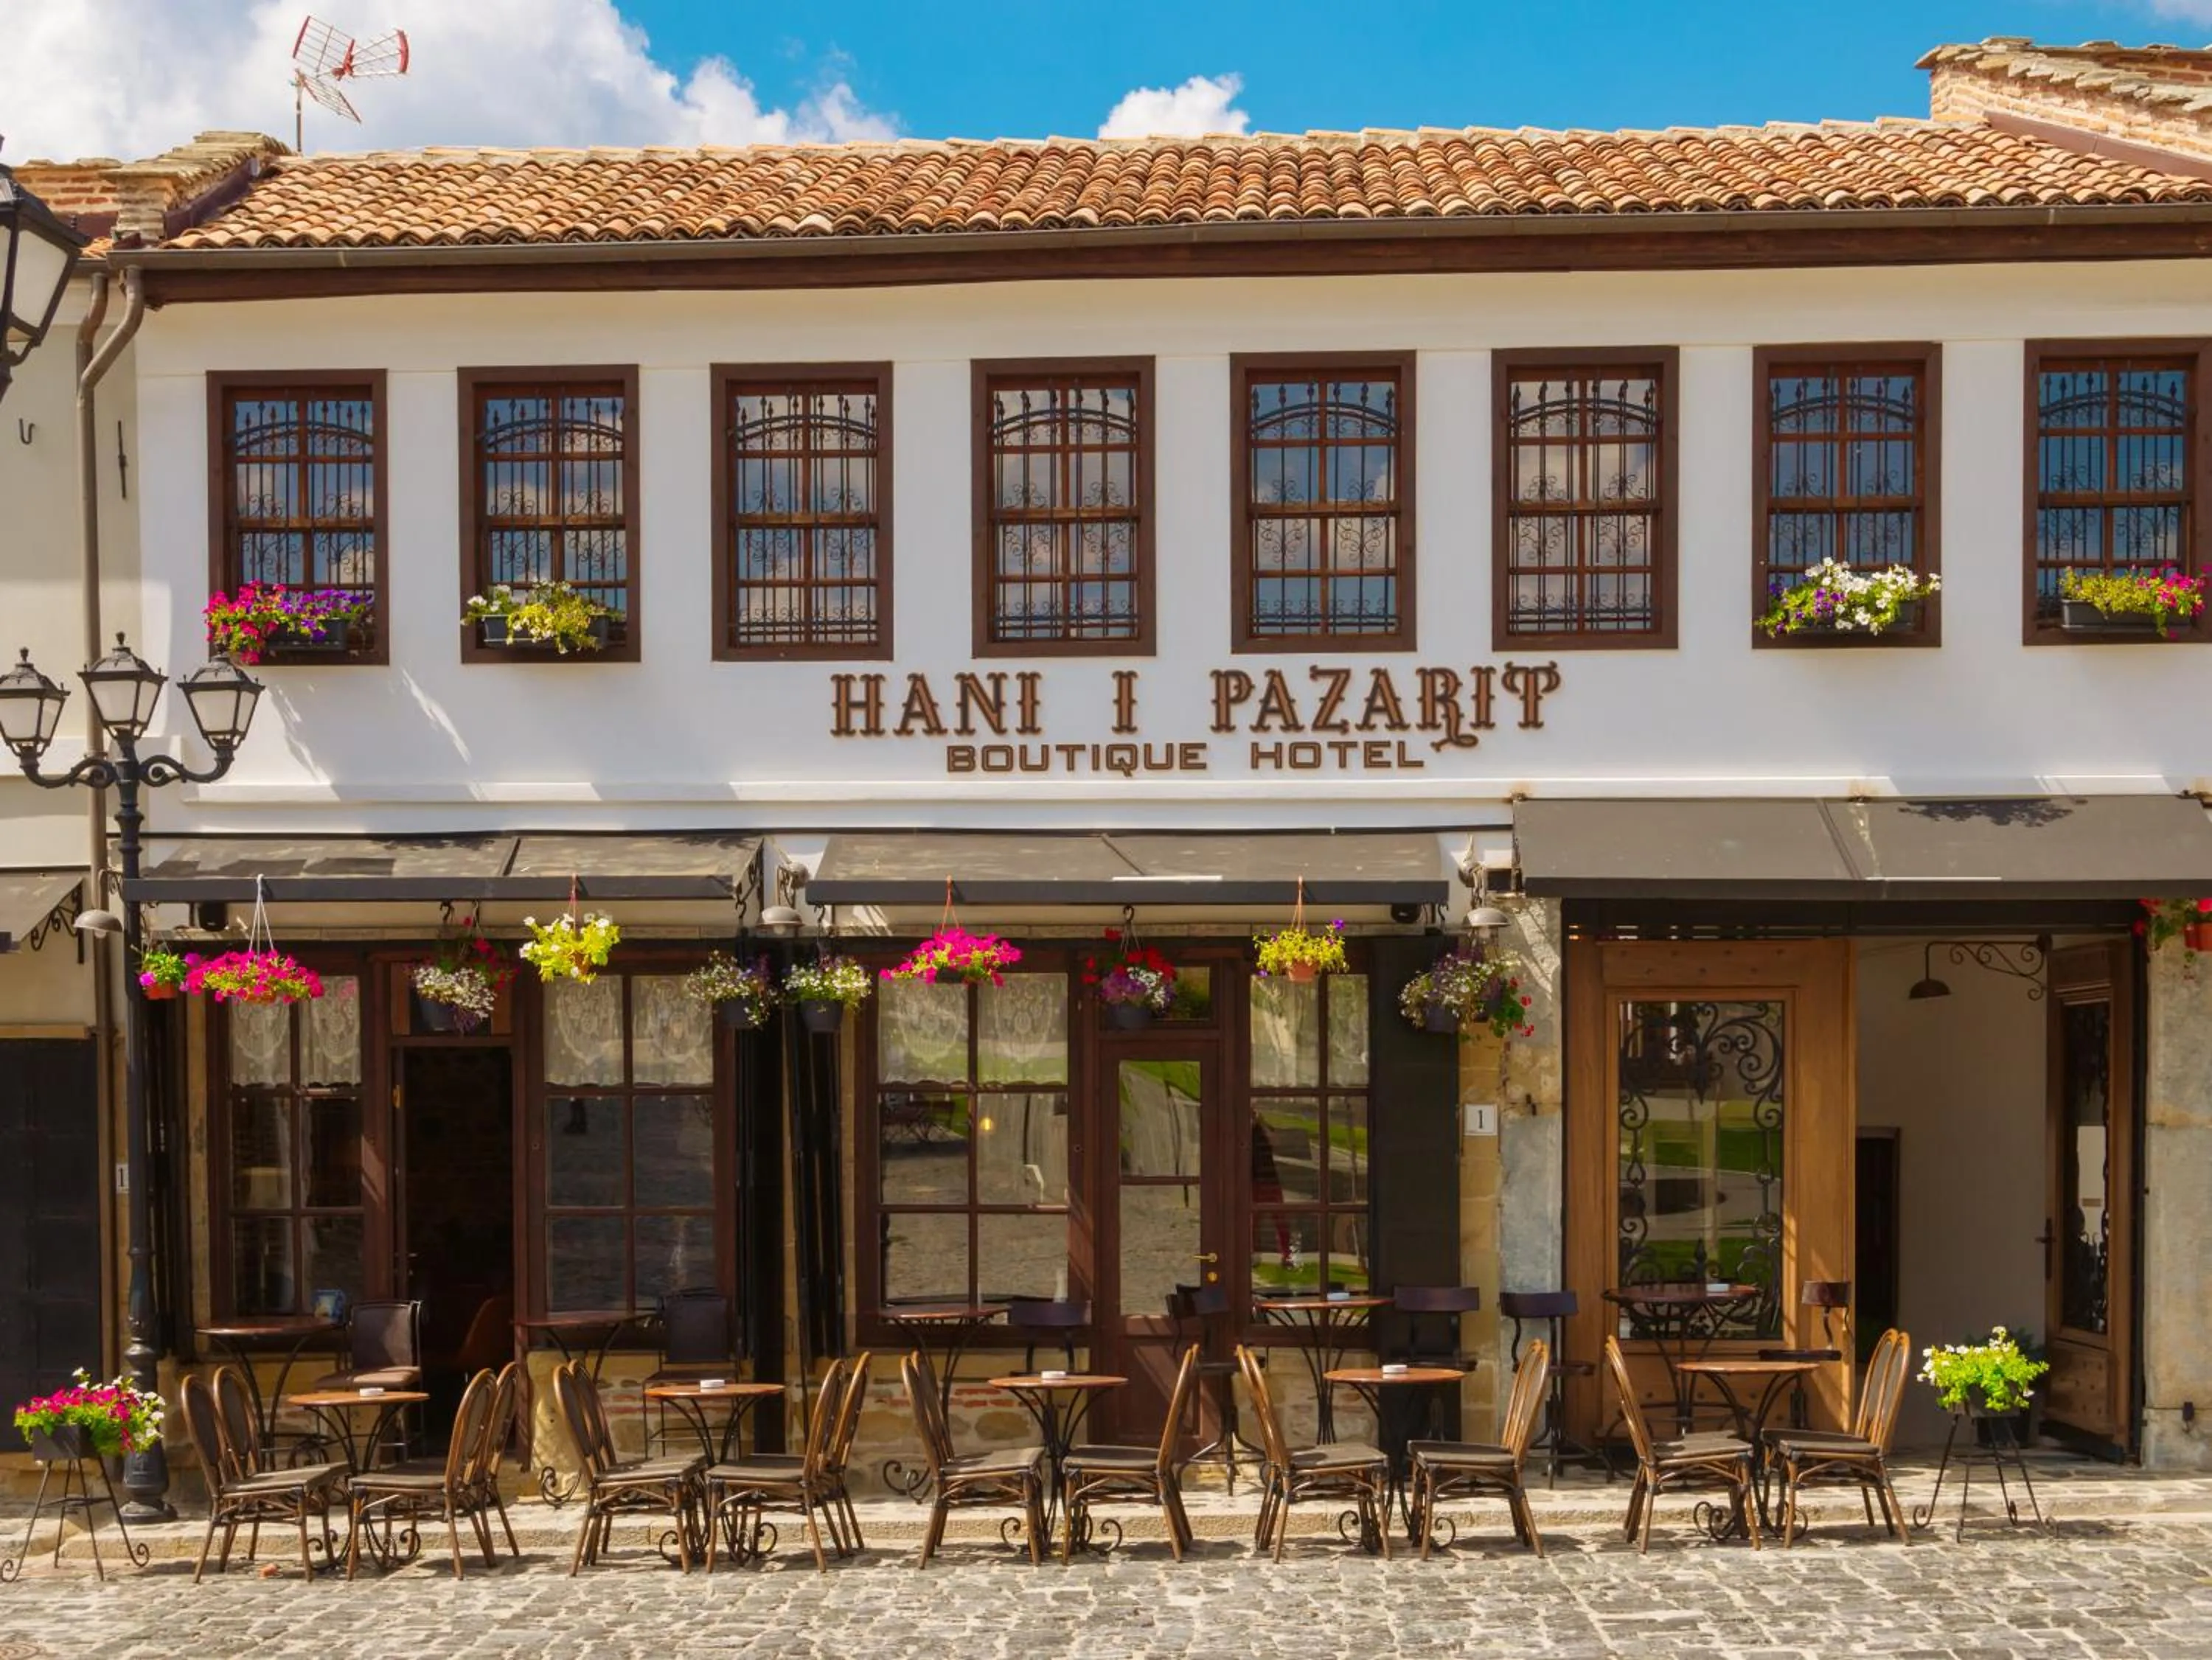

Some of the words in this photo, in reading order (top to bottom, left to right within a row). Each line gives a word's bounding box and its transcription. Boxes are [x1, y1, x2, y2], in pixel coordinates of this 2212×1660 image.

[830, 672, 1042, 737] HANI
[1111, 670, 1138, 735] I
[1209, 663, 1562, 753] PAZARIT
[946, 742, 1207, 778] BOUTIQUE
[1251, 740, 1425, 770] HOTEL
